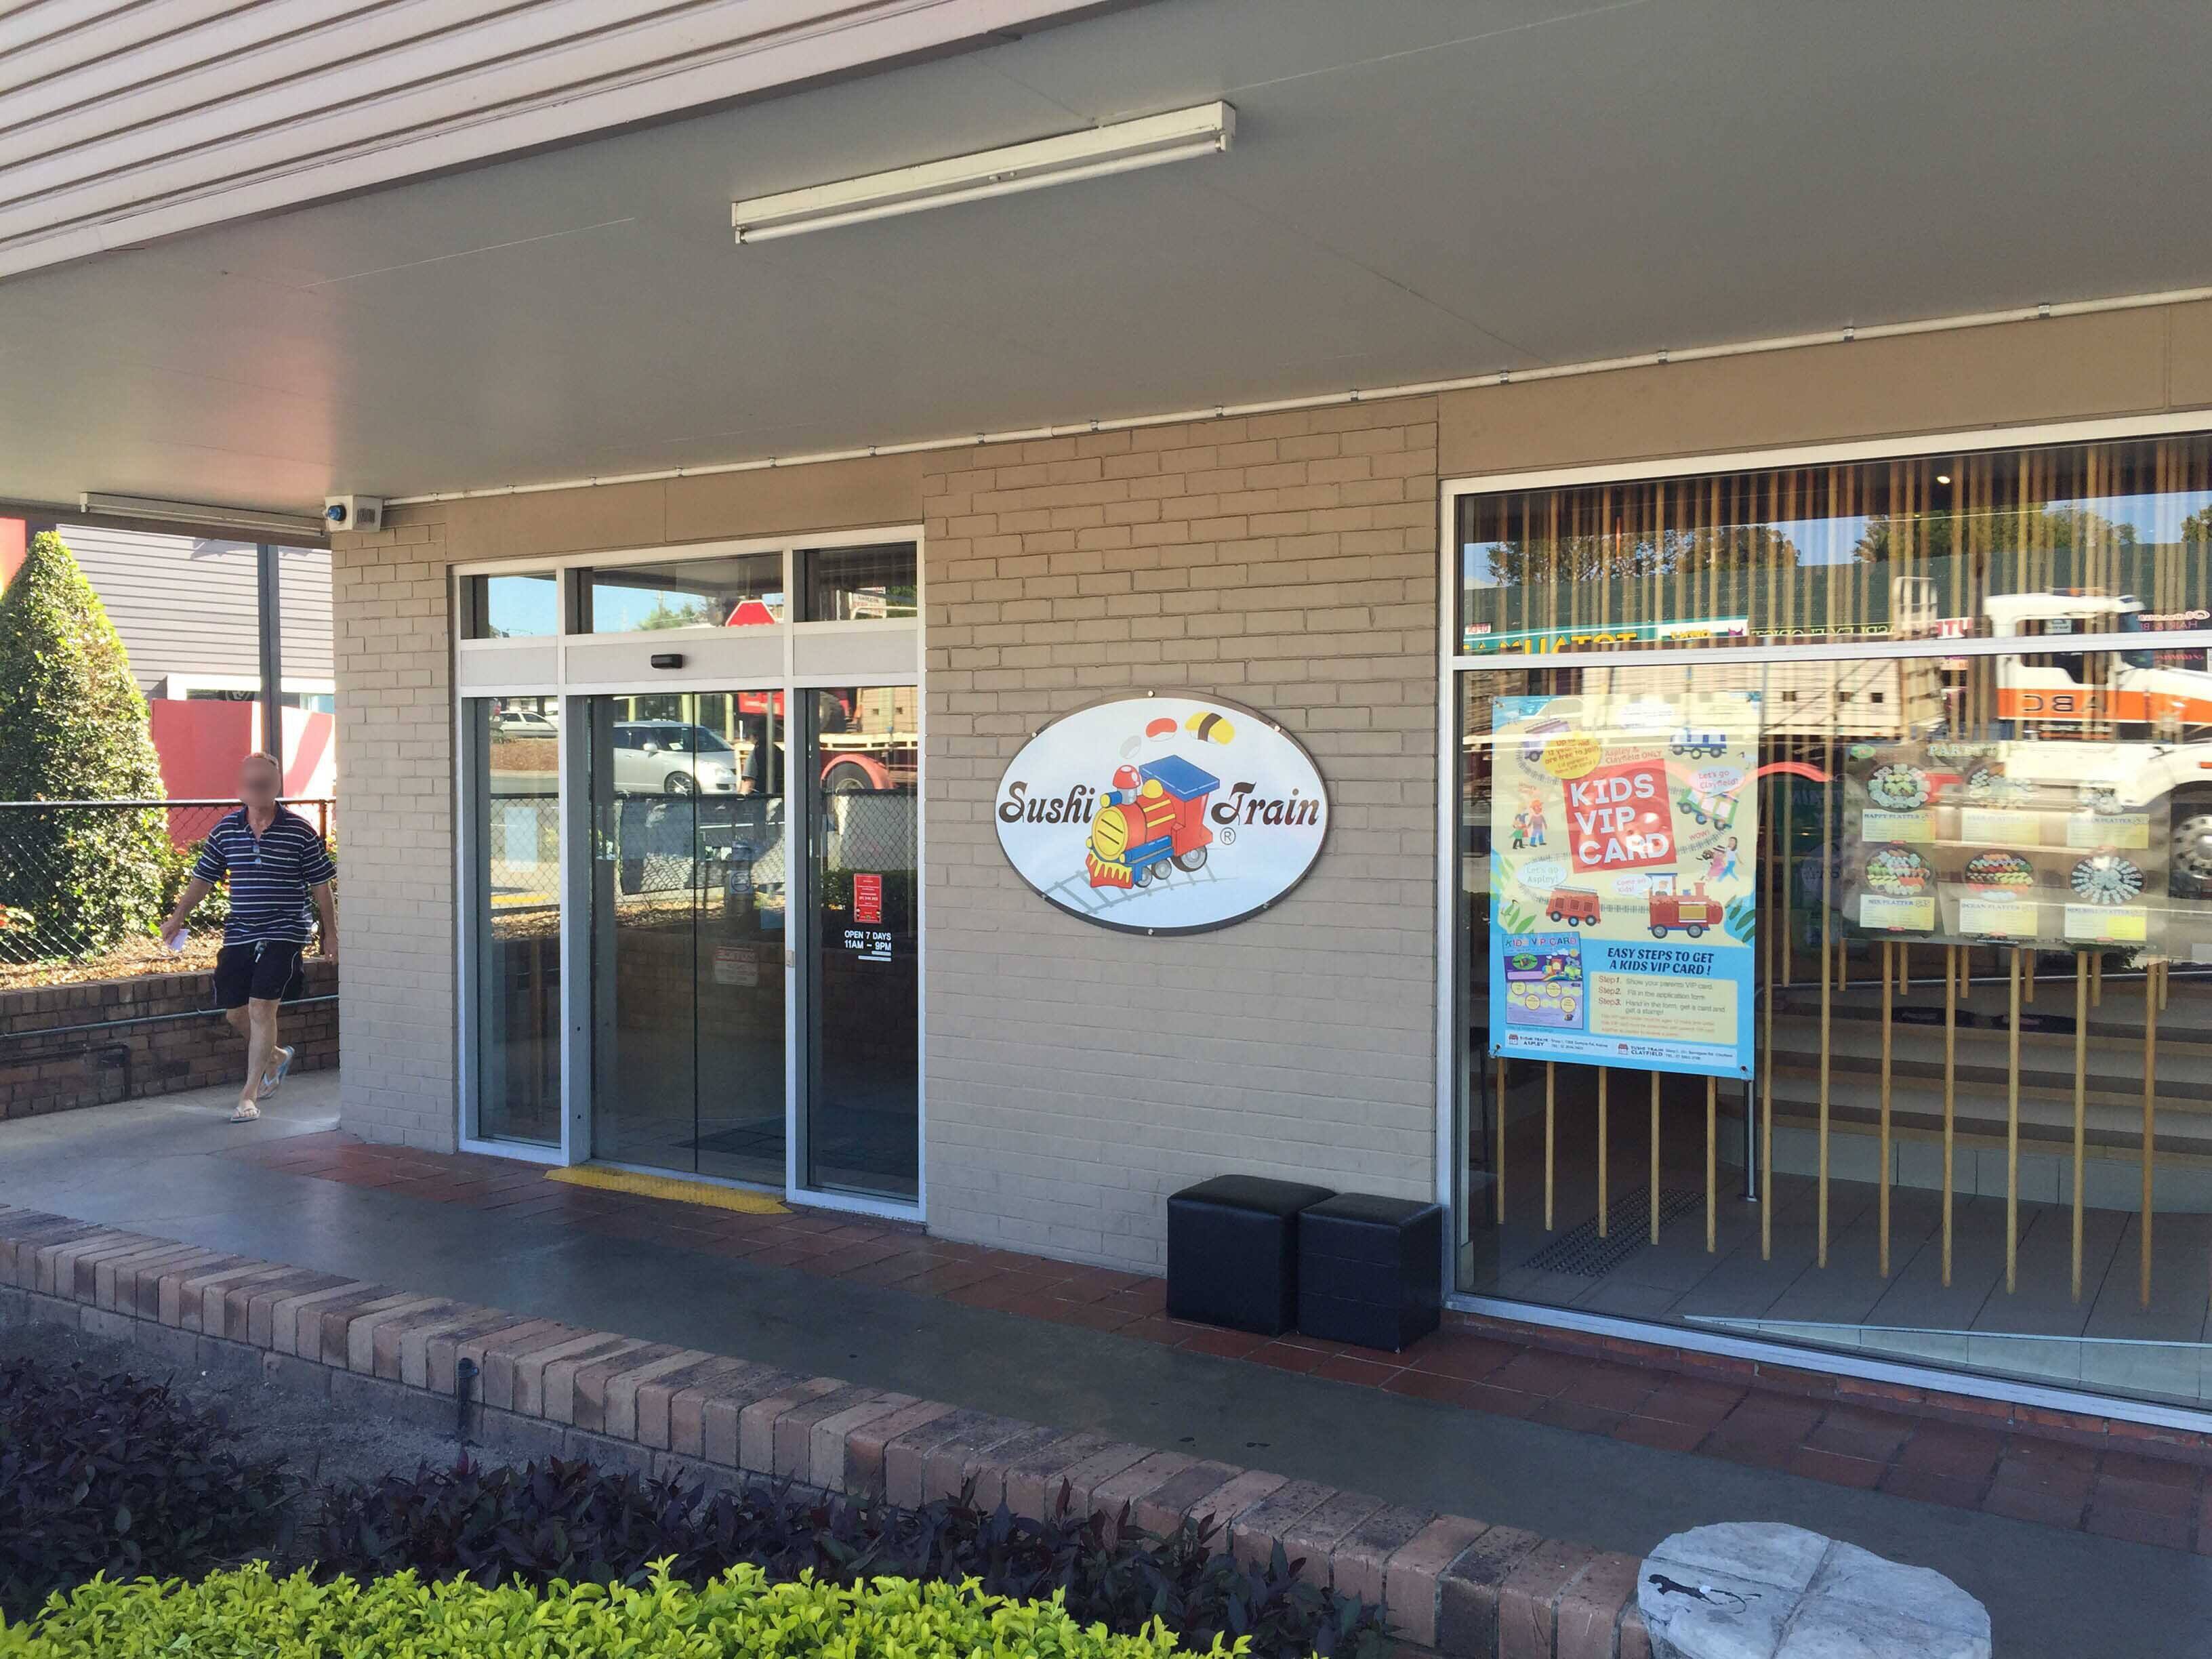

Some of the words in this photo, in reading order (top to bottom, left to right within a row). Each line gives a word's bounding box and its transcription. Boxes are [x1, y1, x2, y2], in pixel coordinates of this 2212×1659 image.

[1569, 773, 1655, 808] KIDS
[999, 780, 1096, 824] Sushi
[1210, 781, 1319, 825] Train
[1574, 805, 1637, 836] VIP
[1578, 832, 1670, 865] CARD
[844, 930, 864, 939] OPEN
[866, 931, 871, 940] 7
[872, 932, 892, 941] DAYS
[1549, 937, 1577, 946] CARD
[844, 940, 864, 949] 11AM
[874, 941, 892, 951] 9PM
[1607, 947, 1636, 958] EASY
[1637, 949, 1673, 961] STEPS
[1675, 951, 1689, 962] TO
[1692, 952, 1715, 964] GET
[1610, 960, 1617, 970] A
[1620, 960, 1648, 971] KIDS
[1650, 962, 1671, 972] VIP
[1673, 962, 1704, 975] CARD
[1656, 991, 1690, 1000] application
[1626, 1000, 1643, 1008] Hand
[1679, 1004, 1691, 1012] get
[1631, 1050, 1664, 1058] CLAYFIELD
